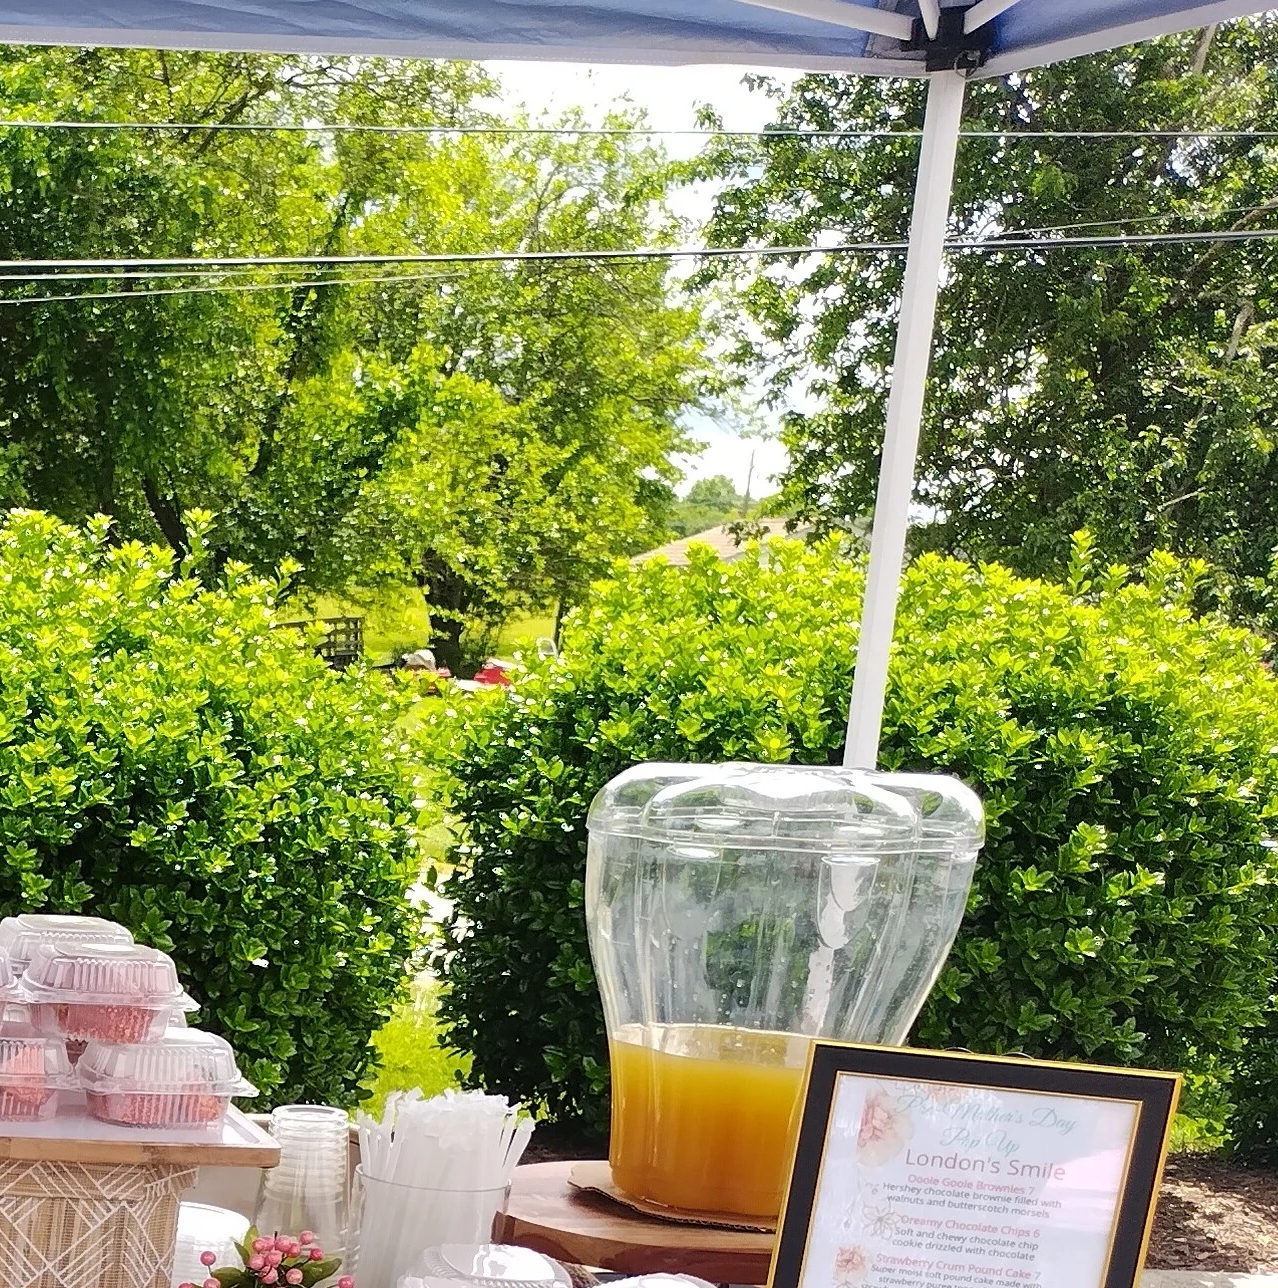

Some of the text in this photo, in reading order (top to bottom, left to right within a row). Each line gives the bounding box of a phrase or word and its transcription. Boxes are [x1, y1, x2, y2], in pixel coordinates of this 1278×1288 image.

[1029, 1107, 1077, 1135] Day
[986, 1130, 1021, 1156] Up
[905, 1148, 1066, 1180] London's Smile
[882, 1182, 1062, 1208] Hershey chocolate brownie filled with
[1027, 1186, 1035, 1195] 7
[886, 1193, 1050, 1218] walnuts and butterscotch morsels
[900, 1214, 1040, 1238] Dreamy Chocolate Chips 6
[892, 1238, 1035, 1261] cookie drizzled with chocolate
[894, 1226, 1039, 1252] Soft and chewy chocolate chip
[870, 1264, 896, 1275] Super
[898, 1267, 922, 1276] moist
[924, 1270, 941, 1278] soft
[943, 1272, 971, 1284] pound
[973, 1276, 993, 1285] cake
[995, 1278, 1020, 1288] made
[875, 1253, 1041, 1280] Strawberry Crum Pound Cake 7
[878, 1275, 924, 1288] strawberry
